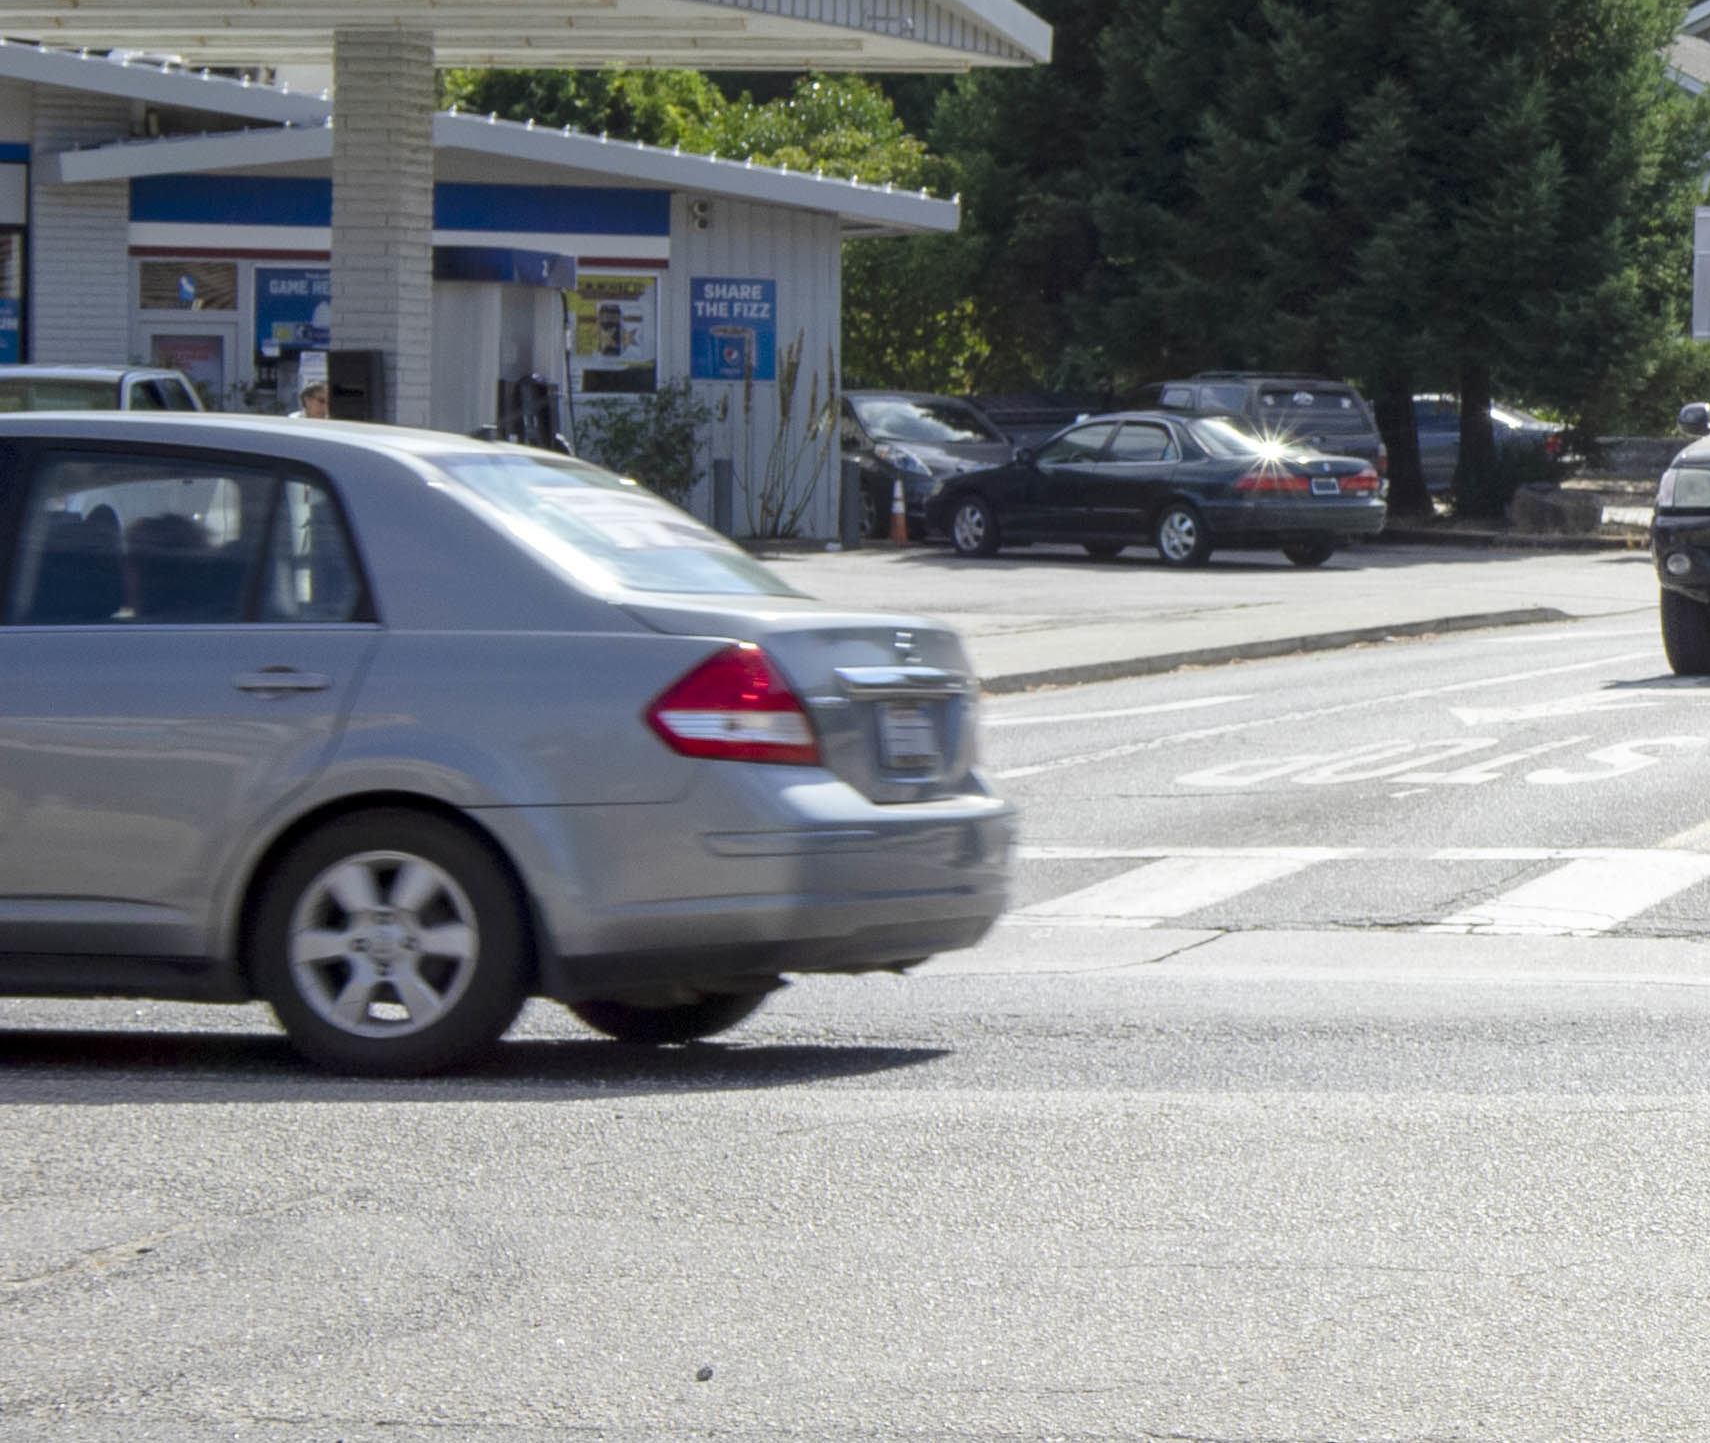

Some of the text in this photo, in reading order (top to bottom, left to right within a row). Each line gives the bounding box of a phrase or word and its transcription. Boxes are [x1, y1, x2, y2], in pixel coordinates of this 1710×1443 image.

[269, 279, 308, 295] GAME
[703, 283, 762, 300] SHARE
[694, 301, 770, 318] THE FIZZ
